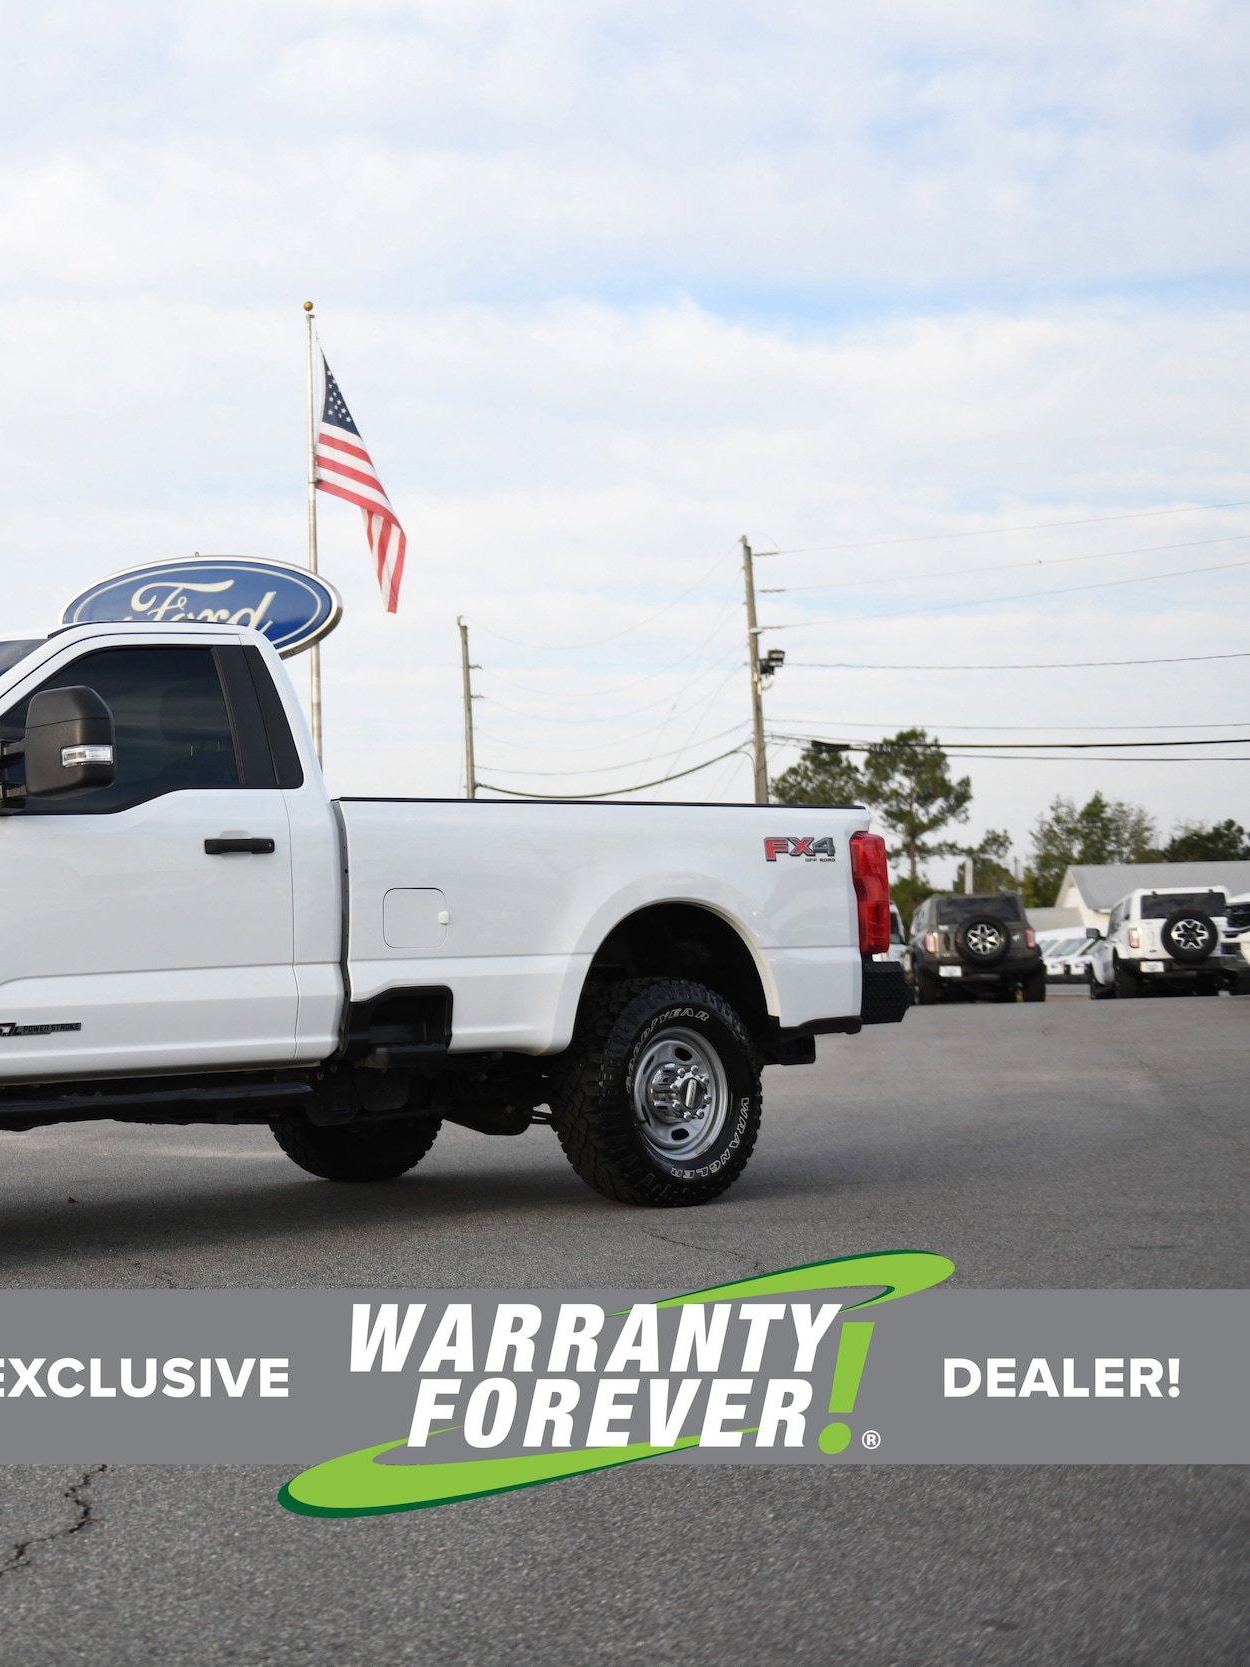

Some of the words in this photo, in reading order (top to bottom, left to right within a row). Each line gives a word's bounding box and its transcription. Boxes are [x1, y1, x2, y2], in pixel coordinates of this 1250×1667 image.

[763, 837, 835, 861] FX4
[23, 1024, 49, 1033] POWER
[51, 1023, 80, 1032] STROKE
[670, 1096, 750, 1179] WRANGLER
